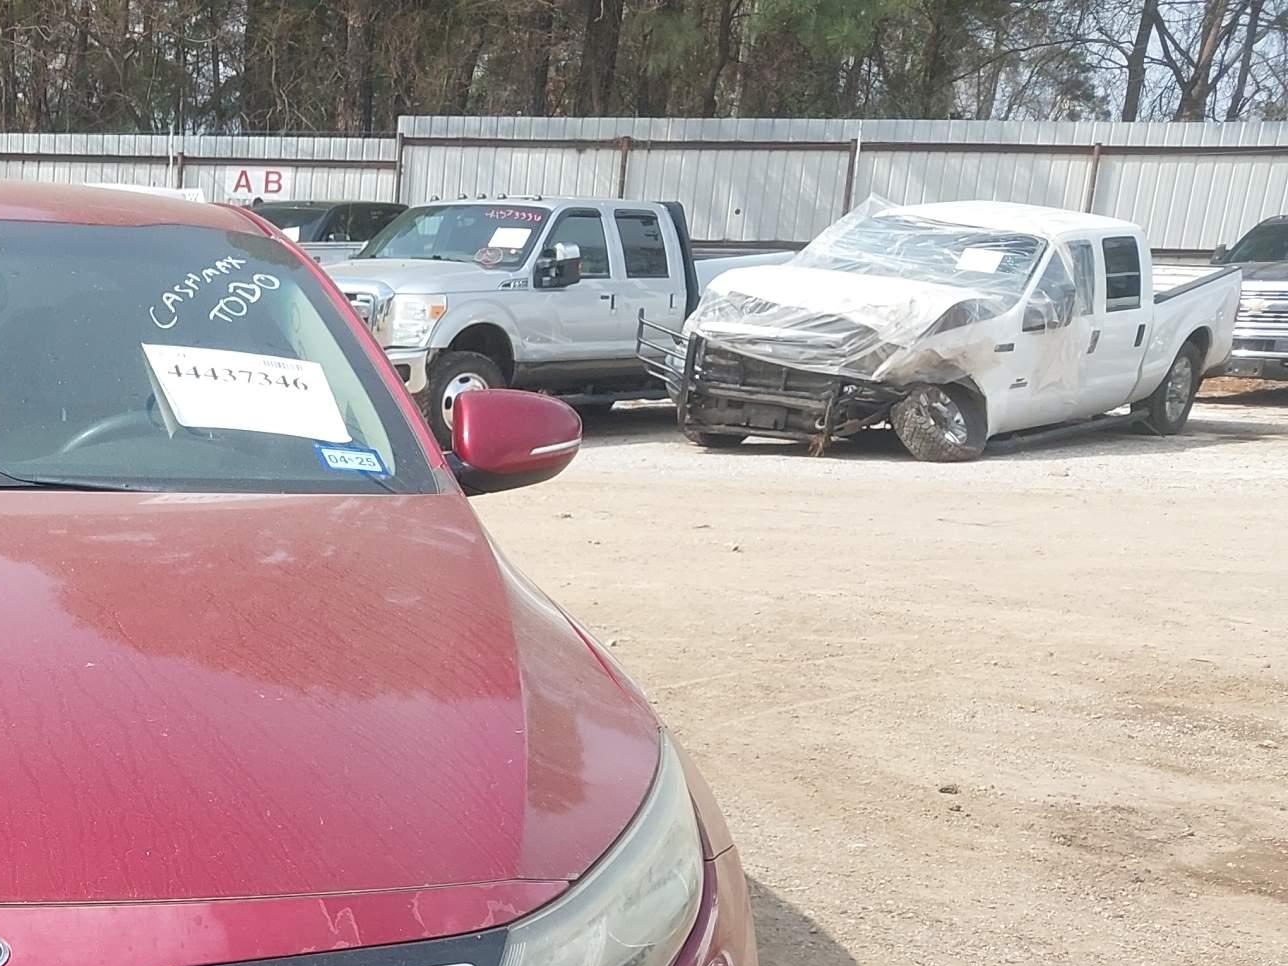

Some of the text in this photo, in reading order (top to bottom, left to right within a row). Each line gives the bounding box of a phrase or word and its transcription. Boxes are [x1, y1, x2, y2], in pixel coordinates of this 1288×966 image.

[233, 170, 283, 194] A B
[209, 273, 281, 323] TODO
[168, 364, 308, 391] 44437346
